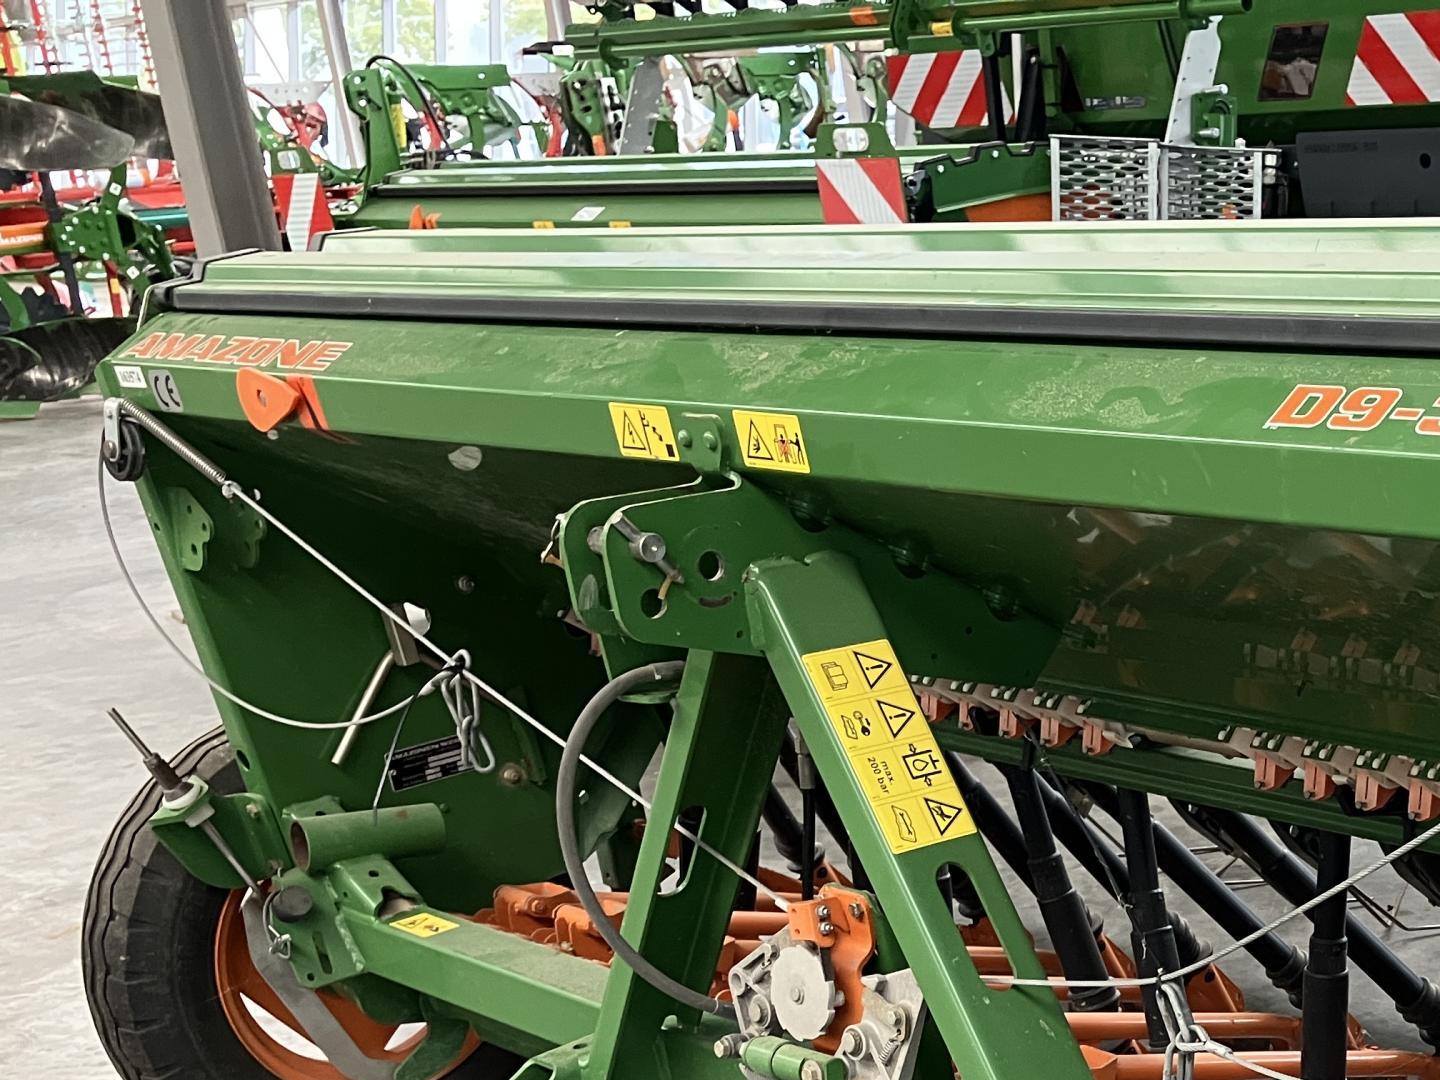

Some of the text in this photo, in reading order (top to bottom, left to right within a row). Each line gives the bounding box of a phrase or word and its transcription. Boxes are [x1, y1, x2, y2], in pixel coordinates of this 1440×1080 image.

[118, 332, 354, 371] AMAZONE
[867, 756, 891, 795] 200 bar
[880, 760, 896, 785] max.
